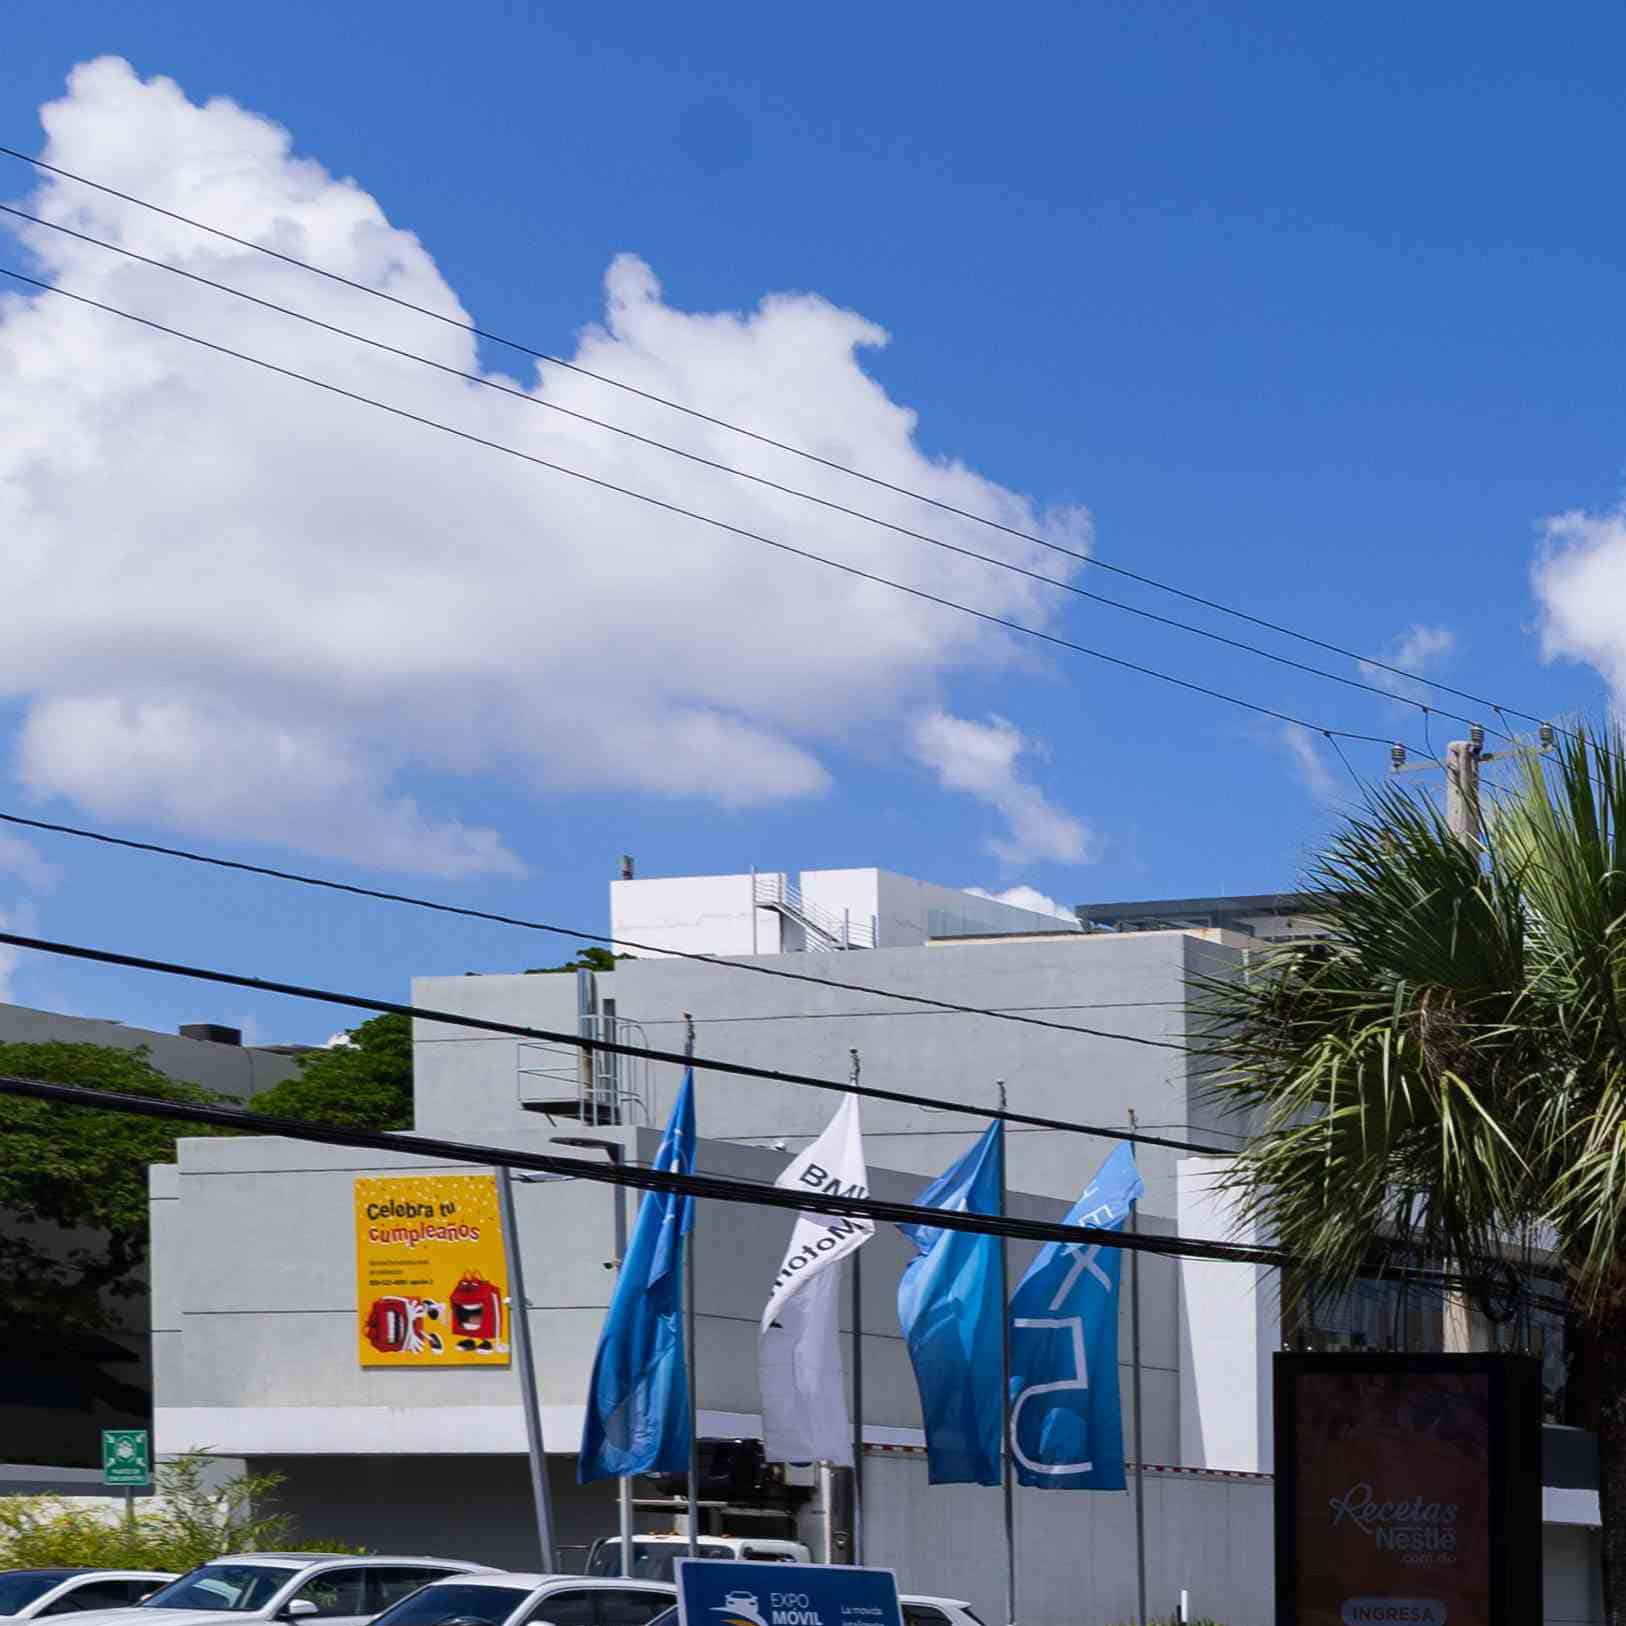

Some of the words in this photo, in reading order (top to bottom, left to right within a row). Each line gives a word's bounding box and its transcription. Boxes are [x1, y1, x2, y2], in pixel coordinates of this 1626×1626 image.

[800, 1163, 870, 1200] BM
[367, 1200, 433, 1220] Celebra
[440, 1201, 456, 1217] tu
[368, 1221, 480, 1248] cumpleaños
[1329, 1482, 1457, 1535] Recetas
[770, 1592, 810, 1609] EXPO
[772, 1607, 823, 1626] MÓVIL
[1352, 1607, 1435, 1621] INGRESA
